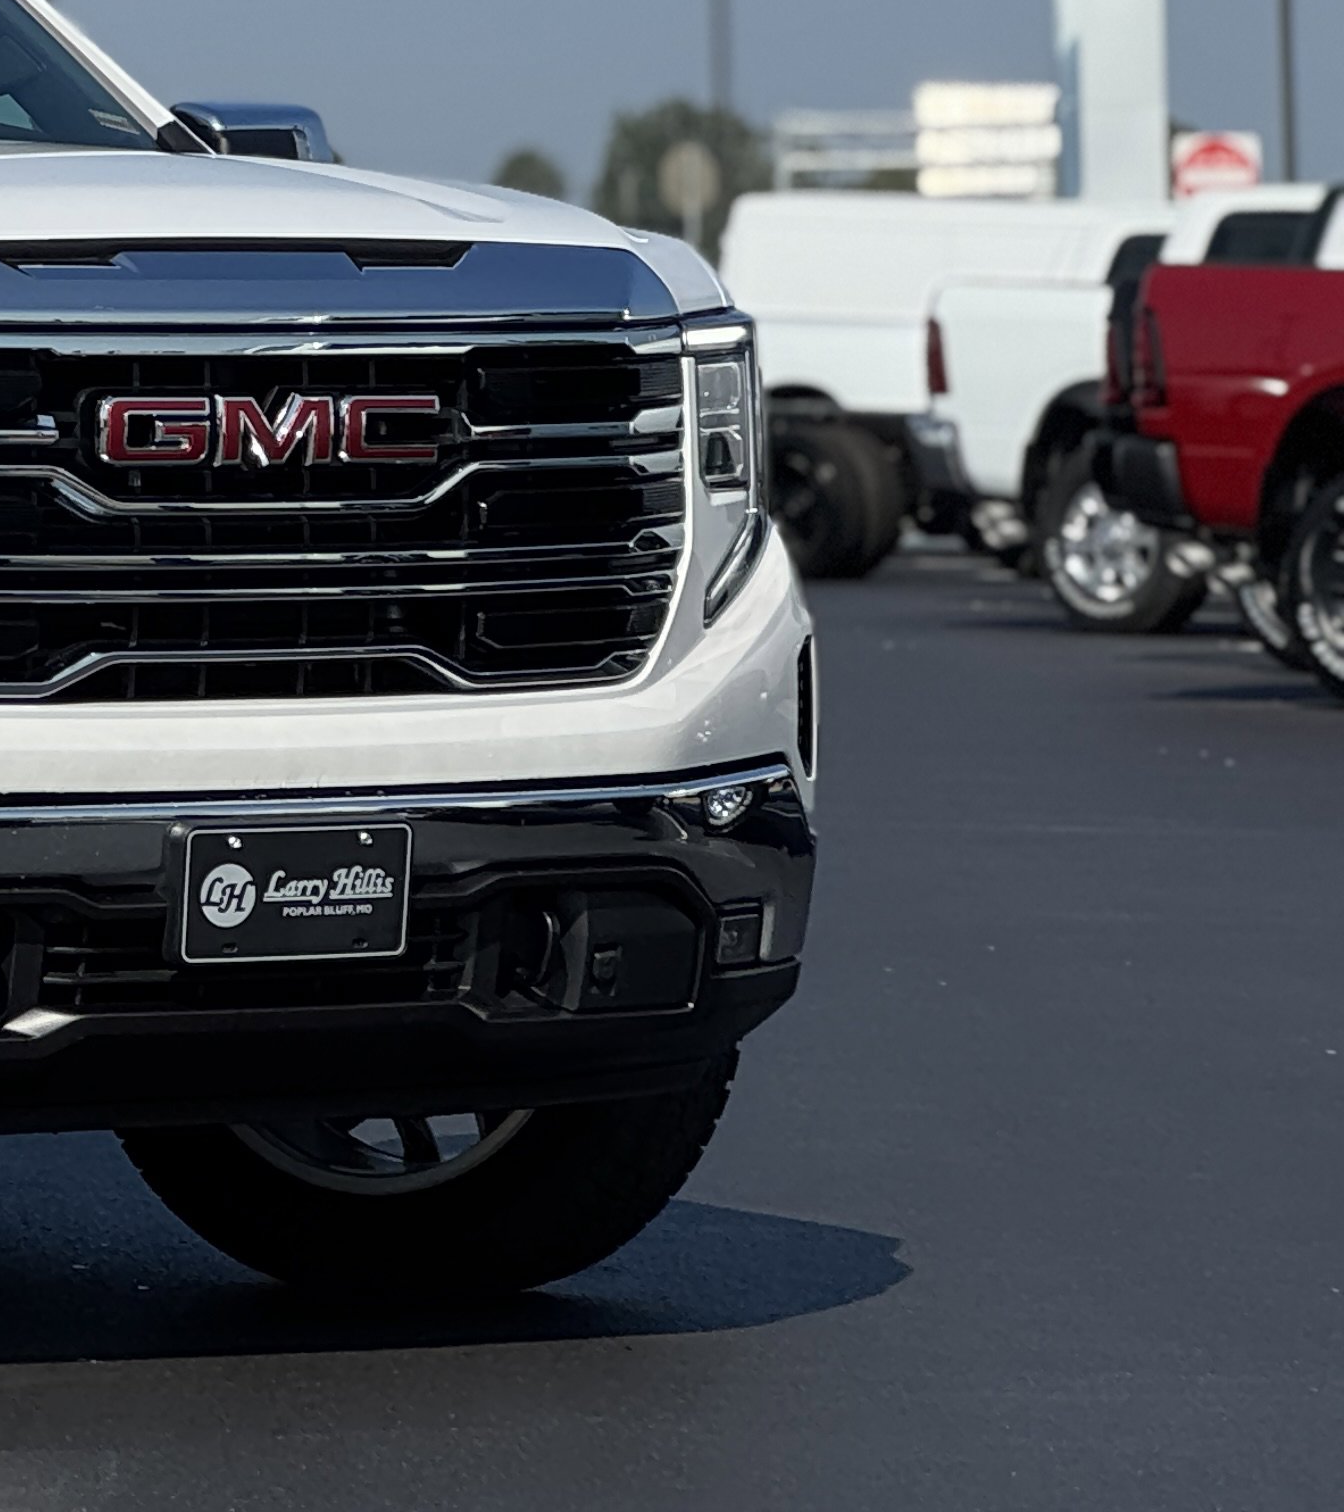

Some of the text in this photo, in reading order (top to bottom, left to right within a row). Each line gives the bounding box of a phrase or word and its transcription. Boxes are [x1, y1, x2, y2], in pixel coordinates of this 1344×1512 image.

[97, 392, 441, 467] GMC
[263, 864, 395, 905] Larry Hillis
[282, 906, 322, 917] POPLAR
